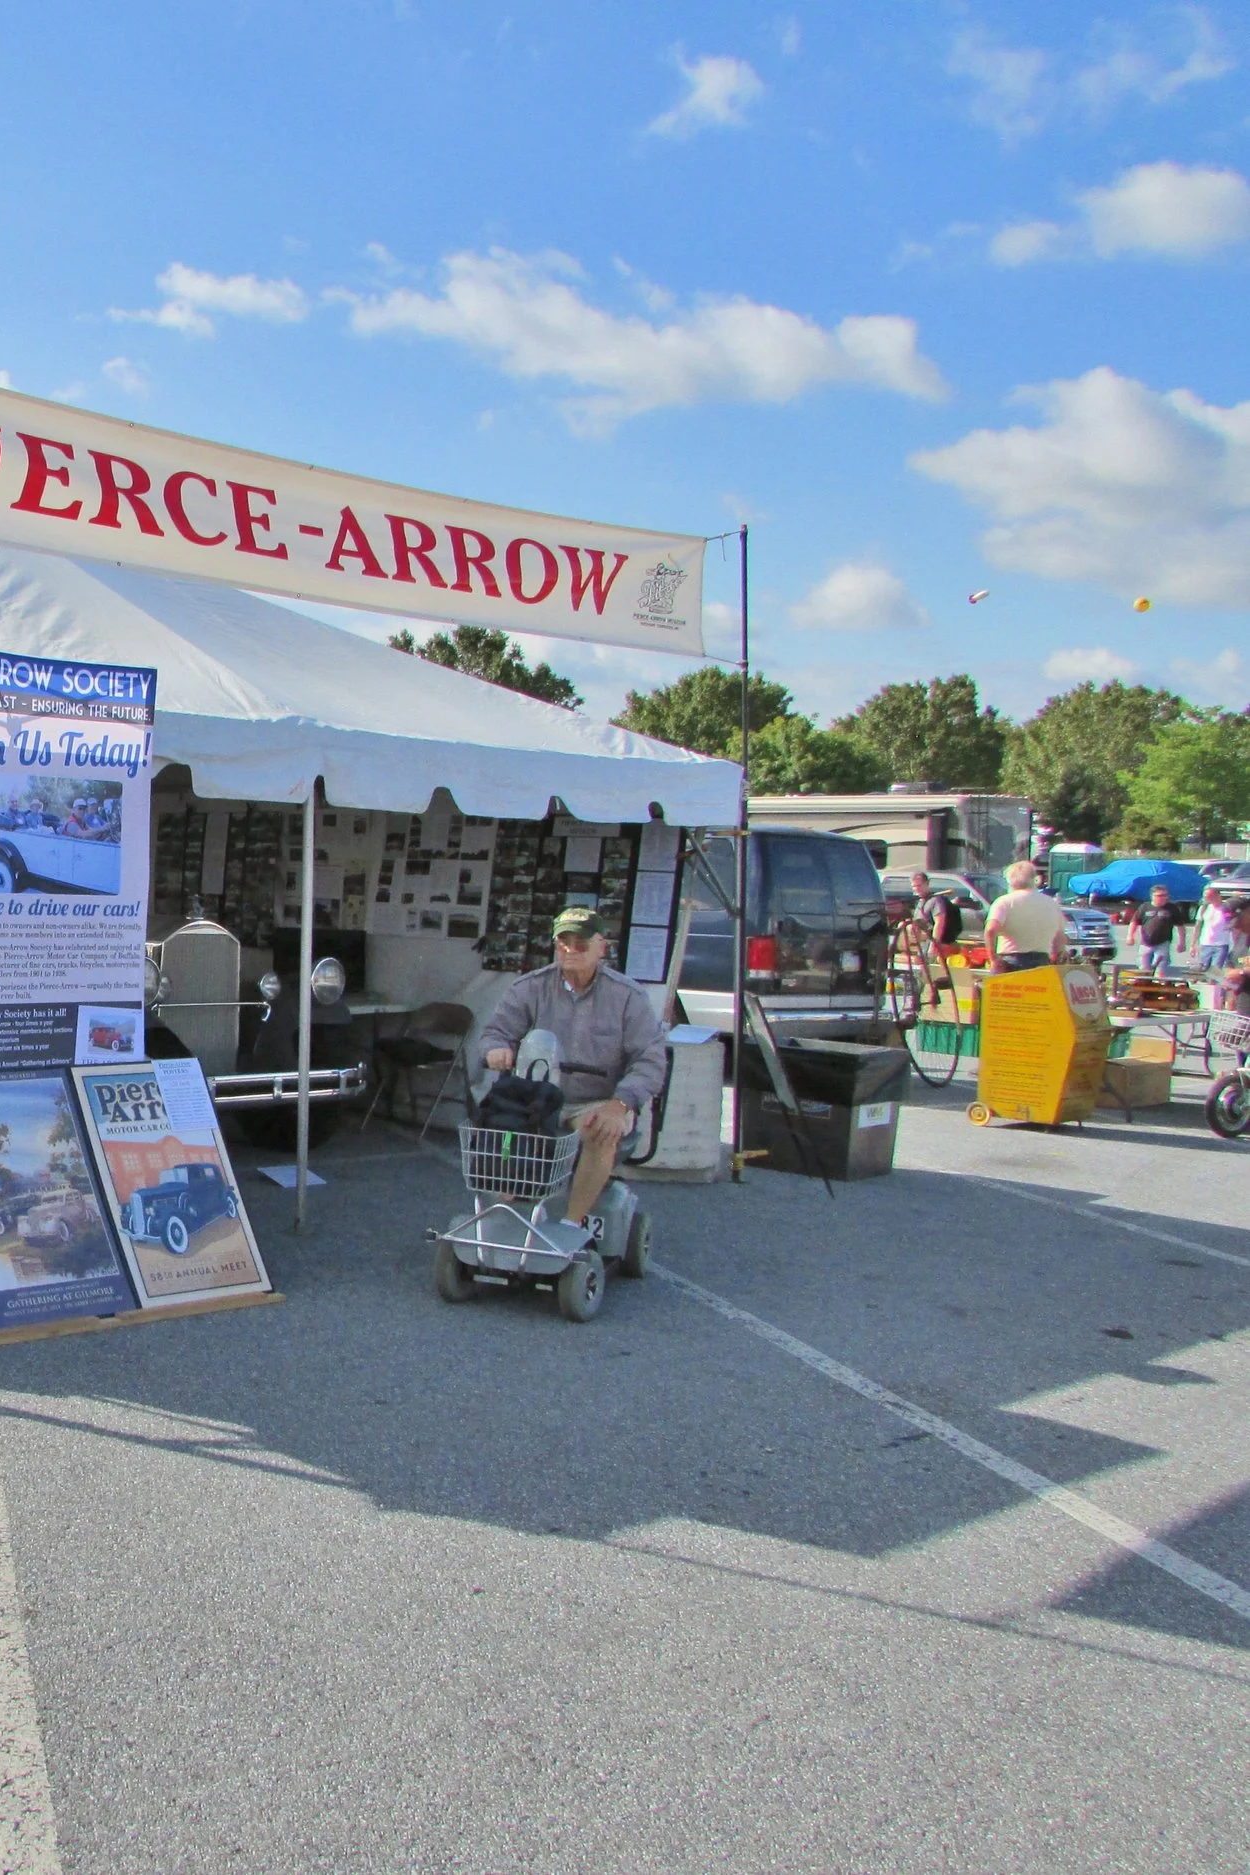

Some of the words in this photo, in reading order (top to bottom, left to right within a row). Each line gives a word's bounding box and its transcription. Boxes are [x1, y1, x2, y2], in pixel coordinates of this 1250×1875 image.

[62, 668, 152, 699] SOCIETY
[32, 699, 83, 716] ENSURING
[88, 703, 107, 718] THE
[112, 705, 151, 722] FUTURE.
[13, 730, 52, 766] Us
[58, 732, 152, 779] Today!
[8, 900, 23, 915] to
[29, 899, 69, 916] drive
[73, 903, 99, 916] our
[103, 901, 141, 916] cars!
[30, 944, 52, 952] Society
[4, 1009, 31, 1019] Society
[33, 1009, 46, 1017] has
[48, 1008, 53, 1017] it
[55, 1008, 66, 1016] all!
[106, 1124, 138, 1134] MOTOR
[140, 1123, 158, 1132] CAR
[176, 1266, 218, 1278] ANNUAL
[220, 1260, 247, 1272] MEET
[7, 1295, 61, 1308] GATHERING
[62, 1292, 72, 1300] AT
[74, 1287, 114, 1298] GILMORE
